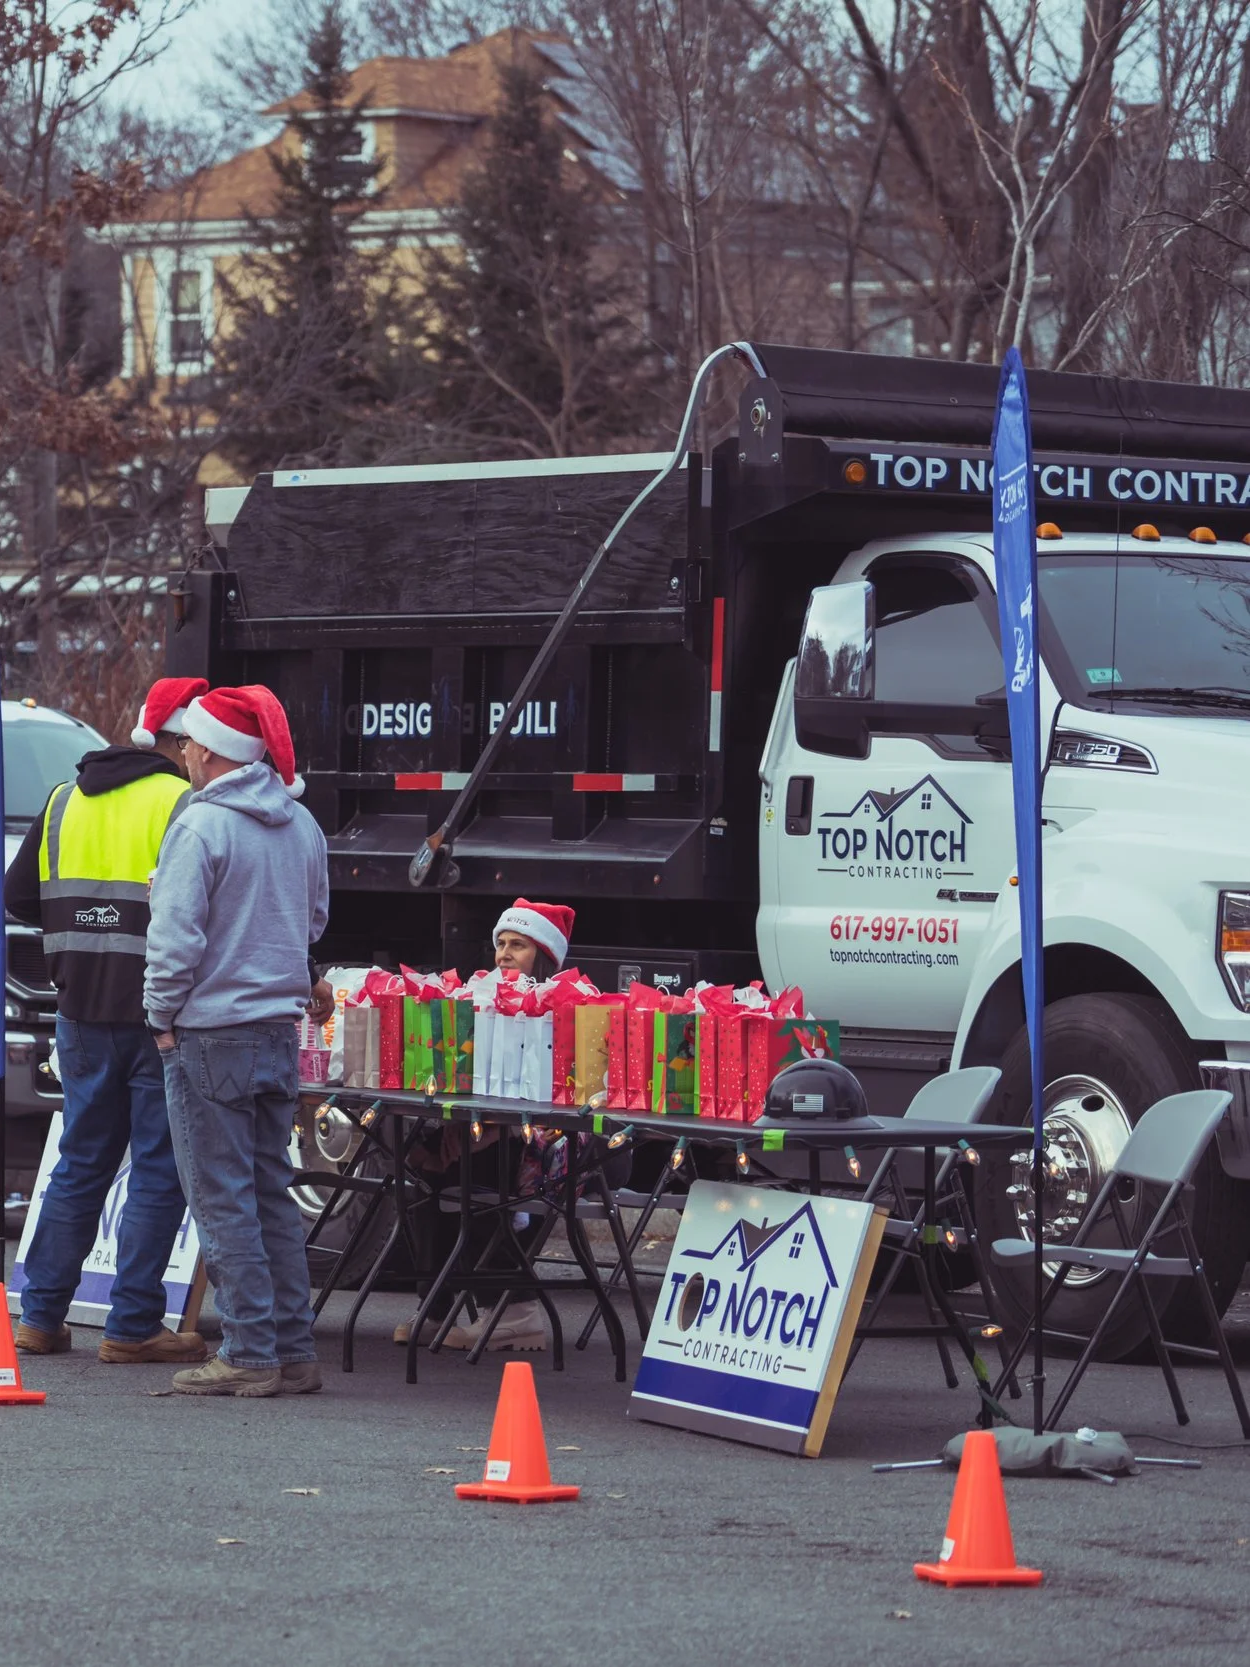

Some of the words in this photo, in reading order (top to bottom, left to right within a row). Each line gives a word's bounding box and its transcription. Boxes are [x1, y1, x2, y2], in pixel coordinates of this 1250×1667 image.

[870, 453, 947, 489] TOP
[960, 459, 1091, 498] NCH
[817, 828, 867, 860] TOP
[876, 815, 966, 862] NOTCH
[849, 865, 943, 879] CONTRACTING
[75, 914, 95, 922] TOP
[830, 915, 959, 943] 617-997-1051
[830, 949, 959, 967] topnotchcontracting.com
[719, 1262, 830, 1349] NOTCH
[683, 1339, 783, 1375] CONTRACTING
